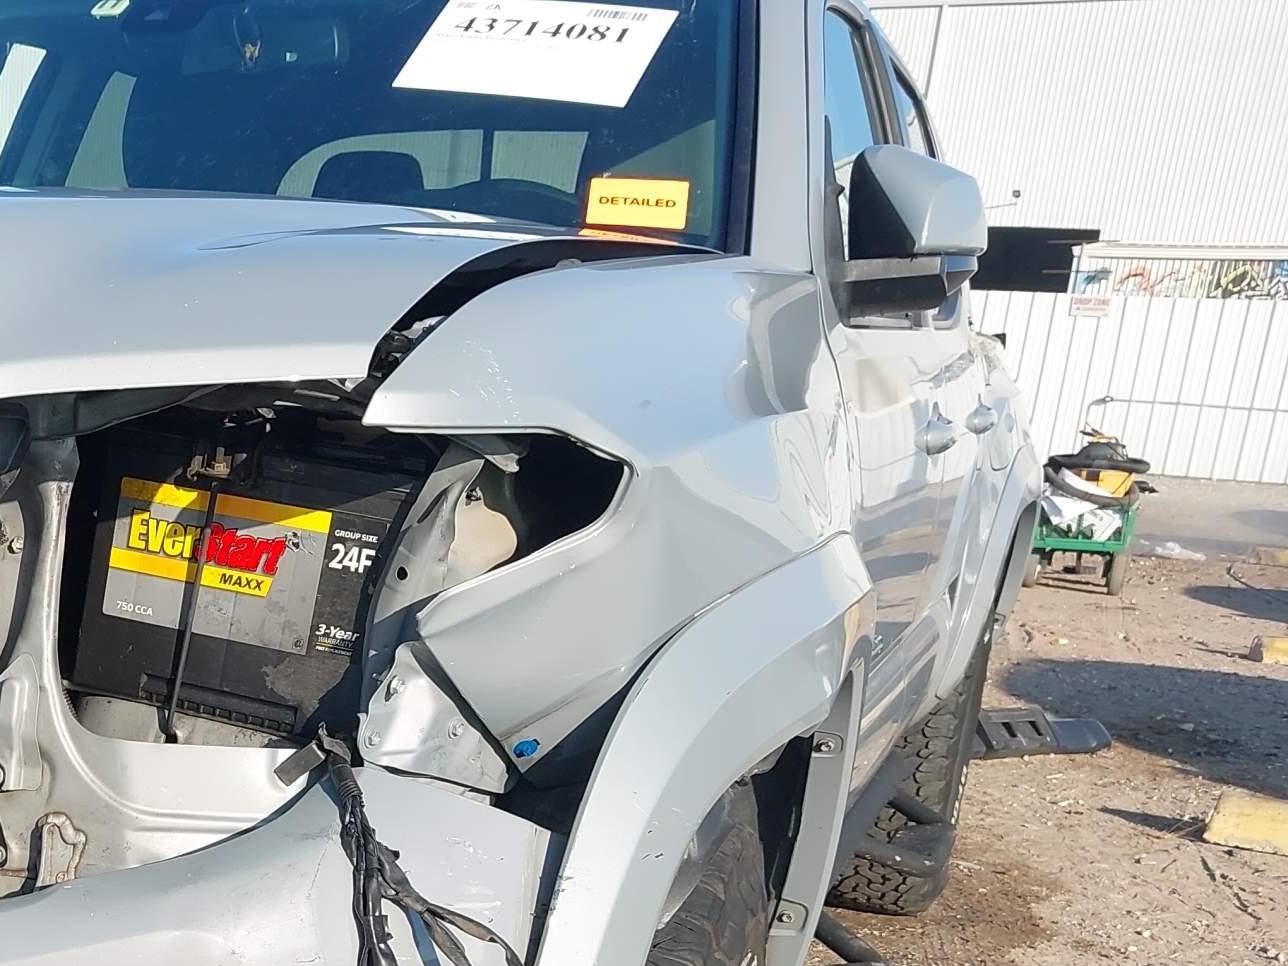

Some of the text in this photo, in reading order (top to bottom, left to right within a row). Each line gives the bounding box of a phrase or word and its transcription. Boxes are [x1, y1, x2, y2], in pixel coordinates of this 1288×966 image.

[454, 16, 630, 43] 43714081
[599, 196, 677, 208] DETAILED
[128, 508, 287, 576] EverStart
[334, 529, 379, 544] GROUP SIZE
[328, 542, 377, 574] 24F
[219, 573, 264, 592] MAXX
[116, 600, 153, 617] 750 CCA
[315, 623, 360, 641] 3-Year
